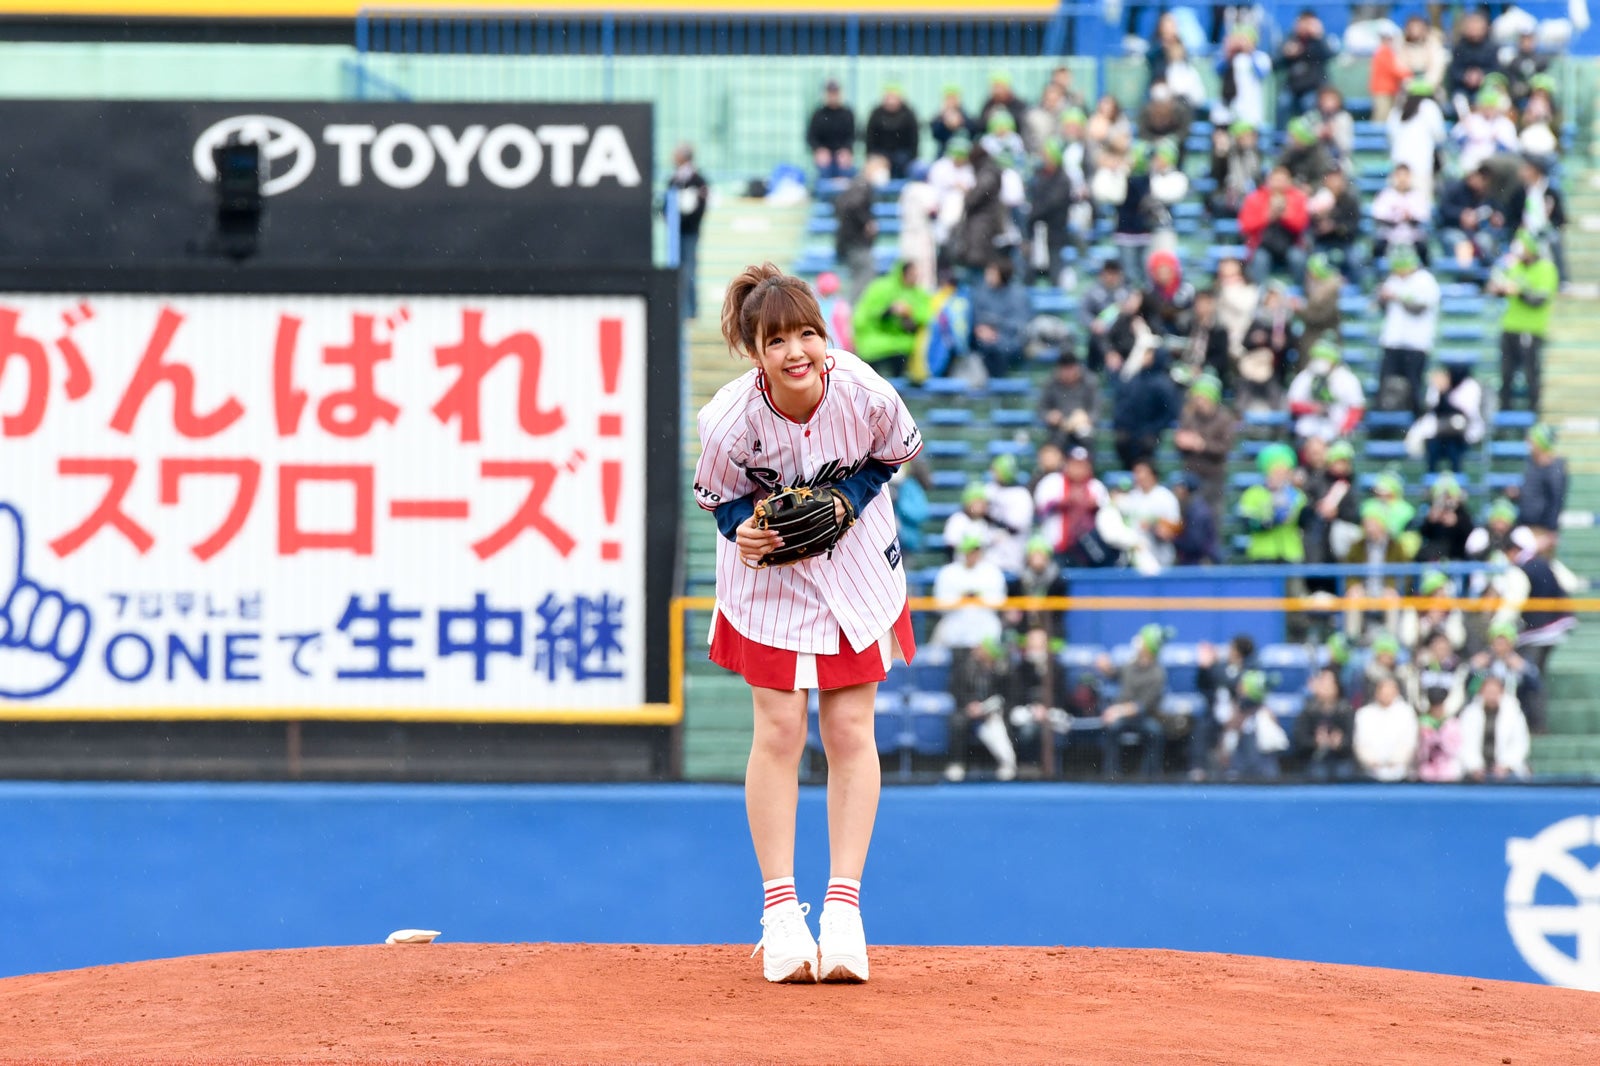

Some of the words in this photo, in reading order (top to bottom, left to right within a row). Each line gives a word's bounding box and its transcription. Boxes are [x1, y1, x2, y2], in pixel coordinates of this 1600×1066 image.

[323, 124, 640, 187] TOYOTA
[48, 451, 621, 561] スワローズ!
